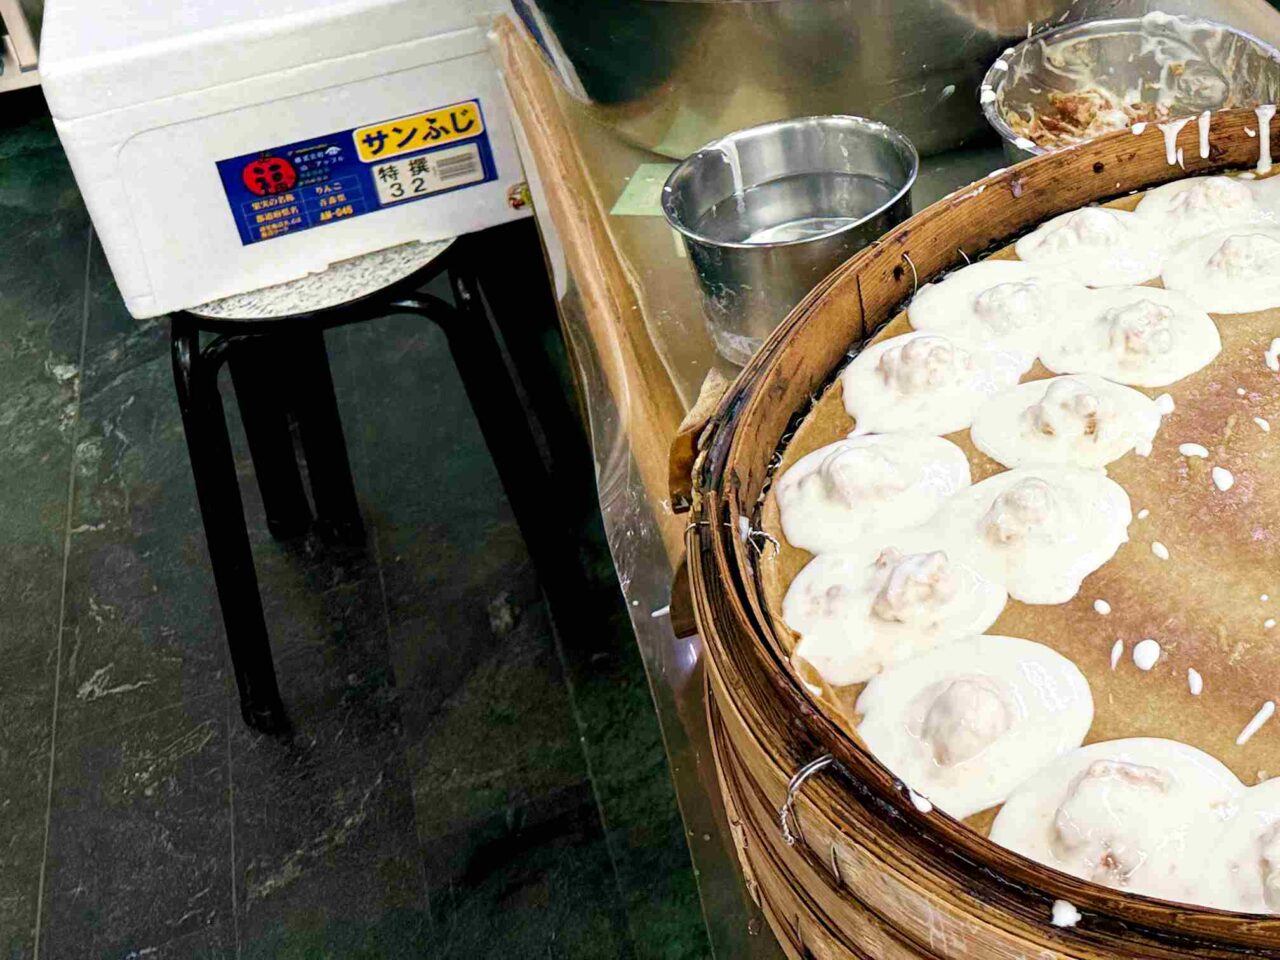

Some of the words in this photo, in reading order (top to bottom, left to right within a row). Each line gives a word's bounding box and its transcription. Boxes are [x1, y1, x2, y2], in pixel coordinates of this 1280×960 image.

[362, 109, 474, 155] サンふじ
[378, 157, 430, 182] 特撰
[389, 177, 427, 198] 32
